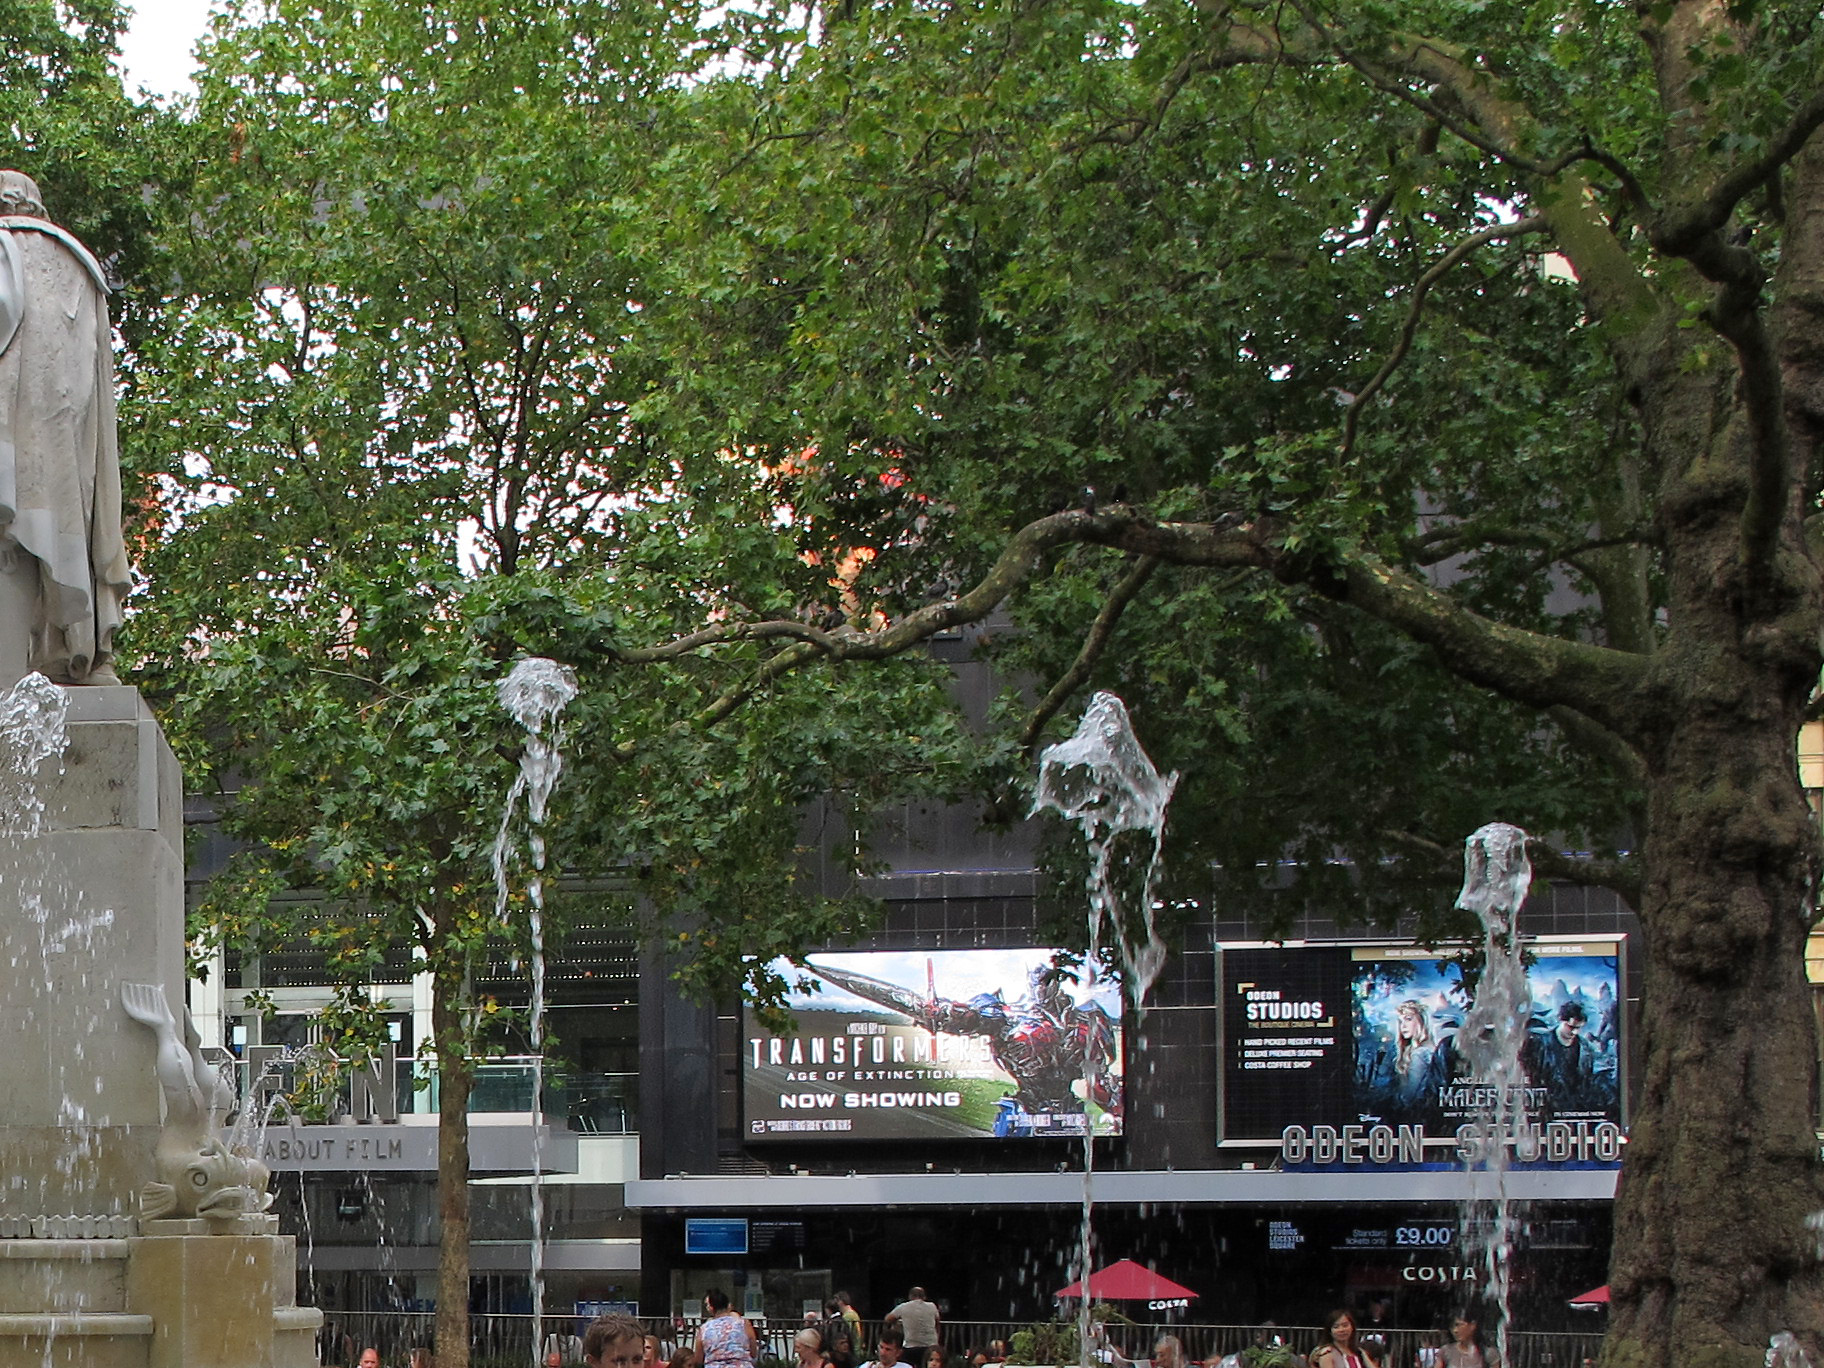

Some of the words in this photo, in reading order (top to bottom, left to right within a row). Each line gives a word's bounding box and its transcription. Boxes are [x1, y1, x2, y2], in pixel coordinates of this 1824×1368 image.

[1246, 1001, 1323, 1020] STUDIOS
[749, 1035, 993, 1069] TRANSFORMERS
[786, 1071, 818, 1081] AGE
[826, 1071, 846, 1081] OF
[854, 1070, 954, 1080] EXTINCTION
[780, 1093, 836, 1108] NOW
[843, 1091, 961, 1108] SHOWING
[263, 1139, 335, 1160] ABOUT
[346, 1139, 402, 1159] FILM
[1282, 1124, 1424, 1163] ODEON
[1402, 1266, 1477, 1281] COSTA
